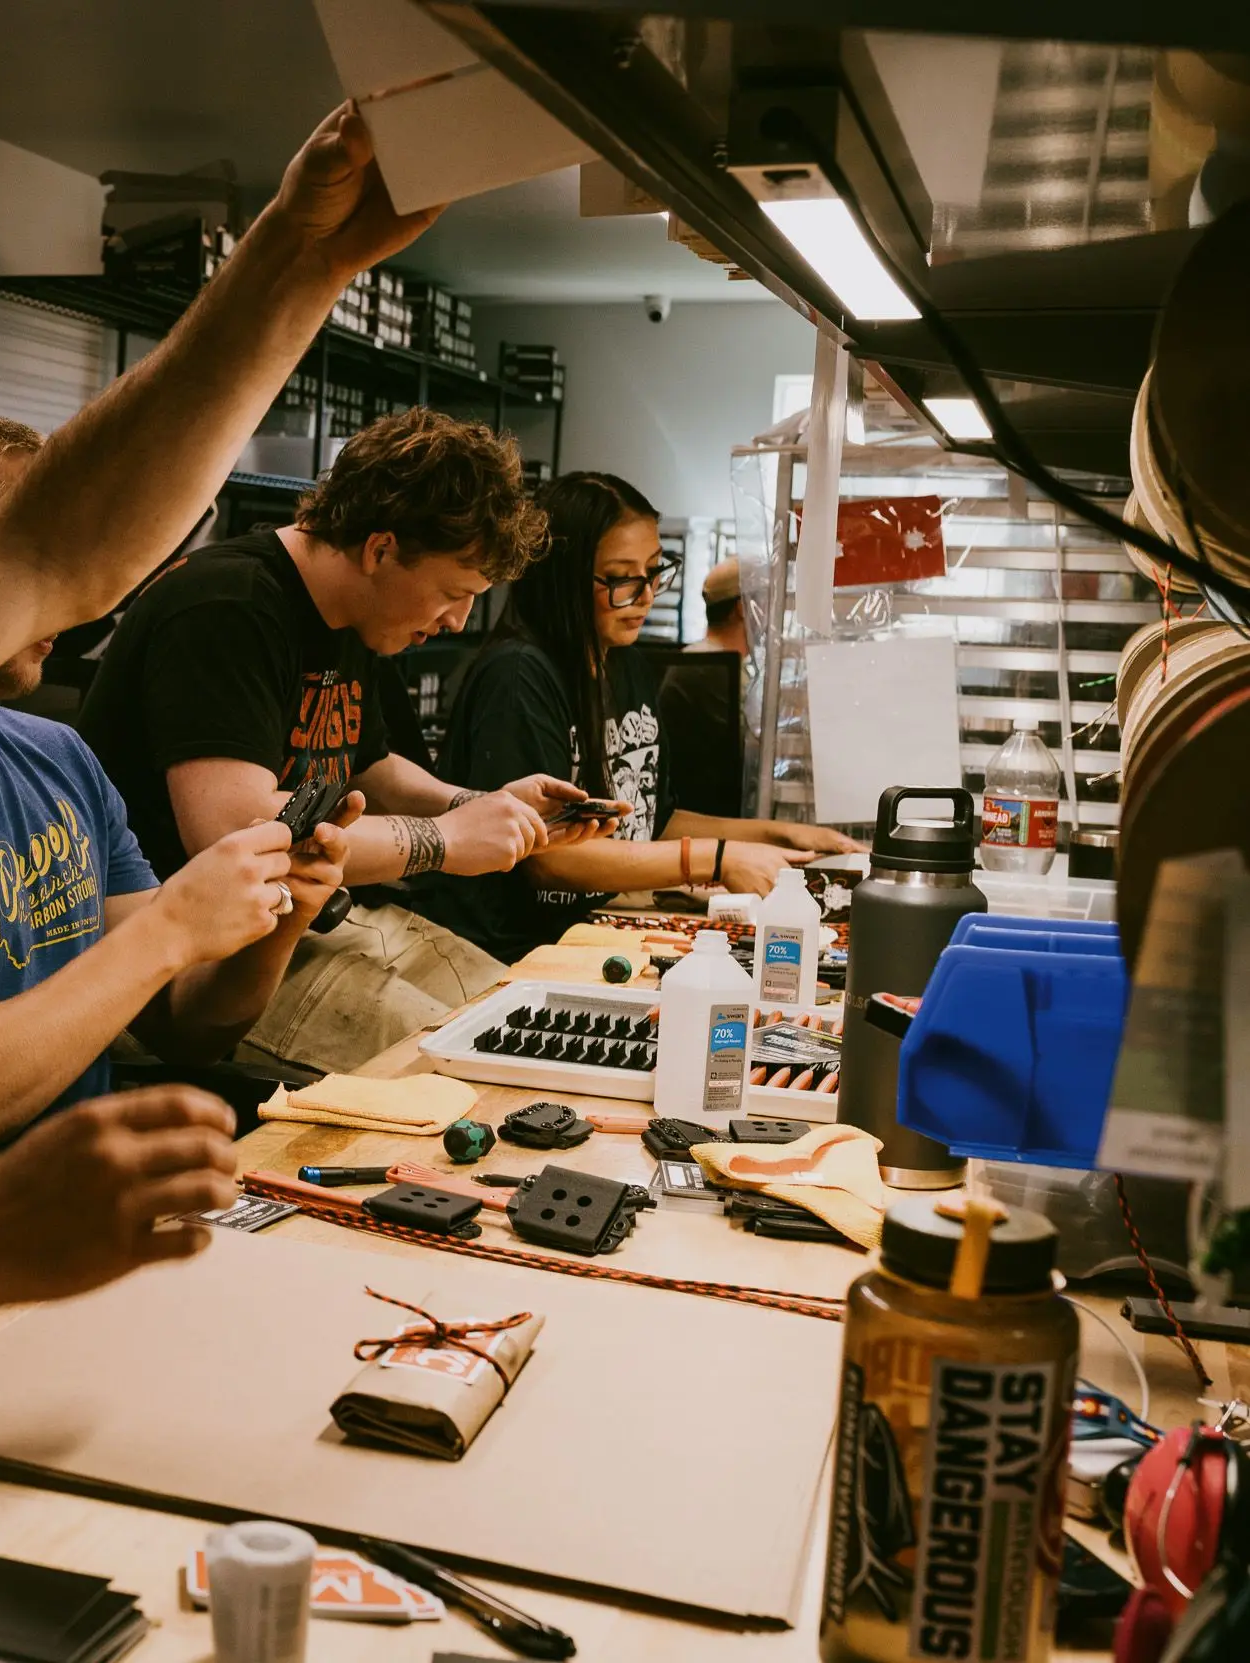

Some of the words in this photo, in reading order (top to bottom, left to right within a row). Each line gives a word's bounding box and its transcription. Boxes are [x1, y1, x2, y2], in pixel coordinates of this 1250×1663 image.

[45, 924, 70, 938] MADE
[768, 944, 787, 955] 70%
[714, 1027, 734, 1039] 70%
[993, 1370, 1045, 1495] STAY
[919, 1366, 996, 1660] DANGEROUS
